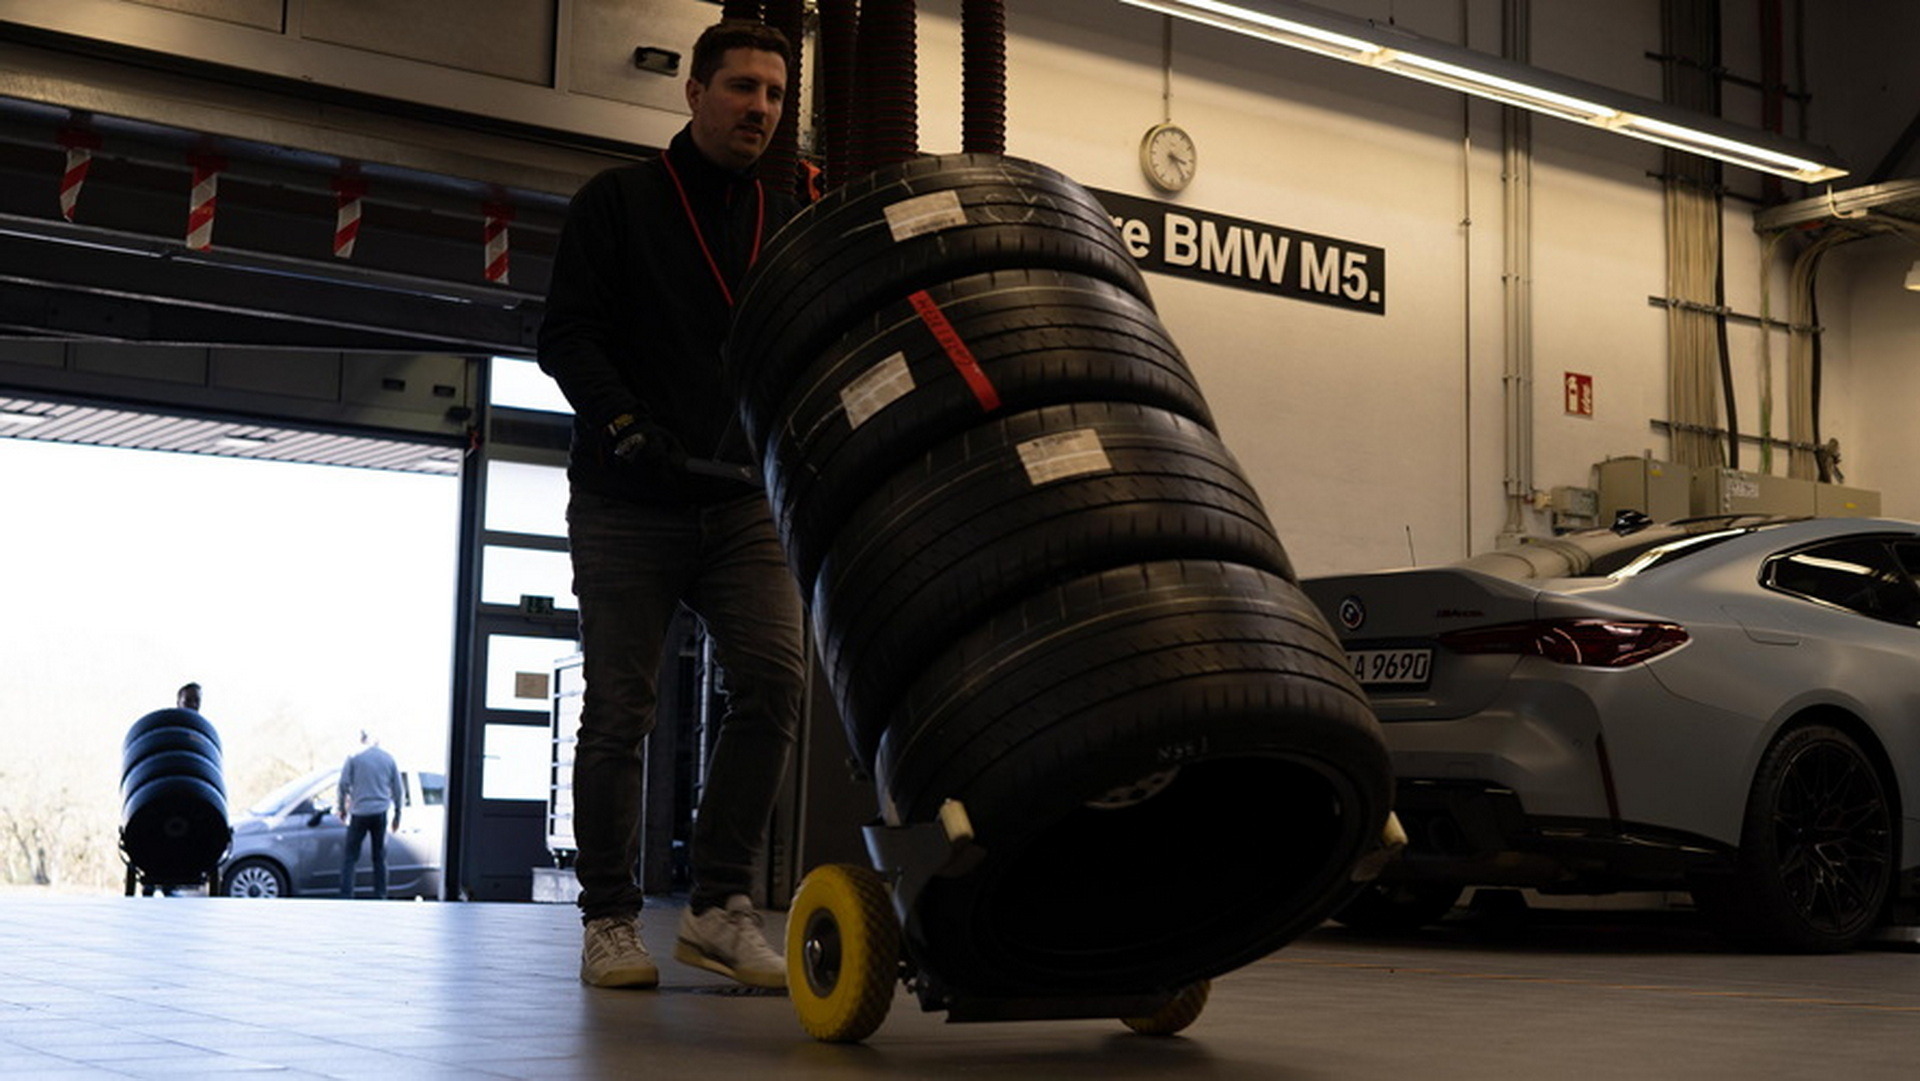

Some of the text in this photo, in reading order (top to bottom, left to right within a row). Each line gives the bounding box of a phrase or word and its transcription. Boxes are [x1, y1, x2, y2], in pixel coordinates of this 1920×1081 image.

[1163, 212, 1290, 285] BMW
[1300, 240, 1380, 304] M5.
[1373, 653, 1428, 680] 9690
